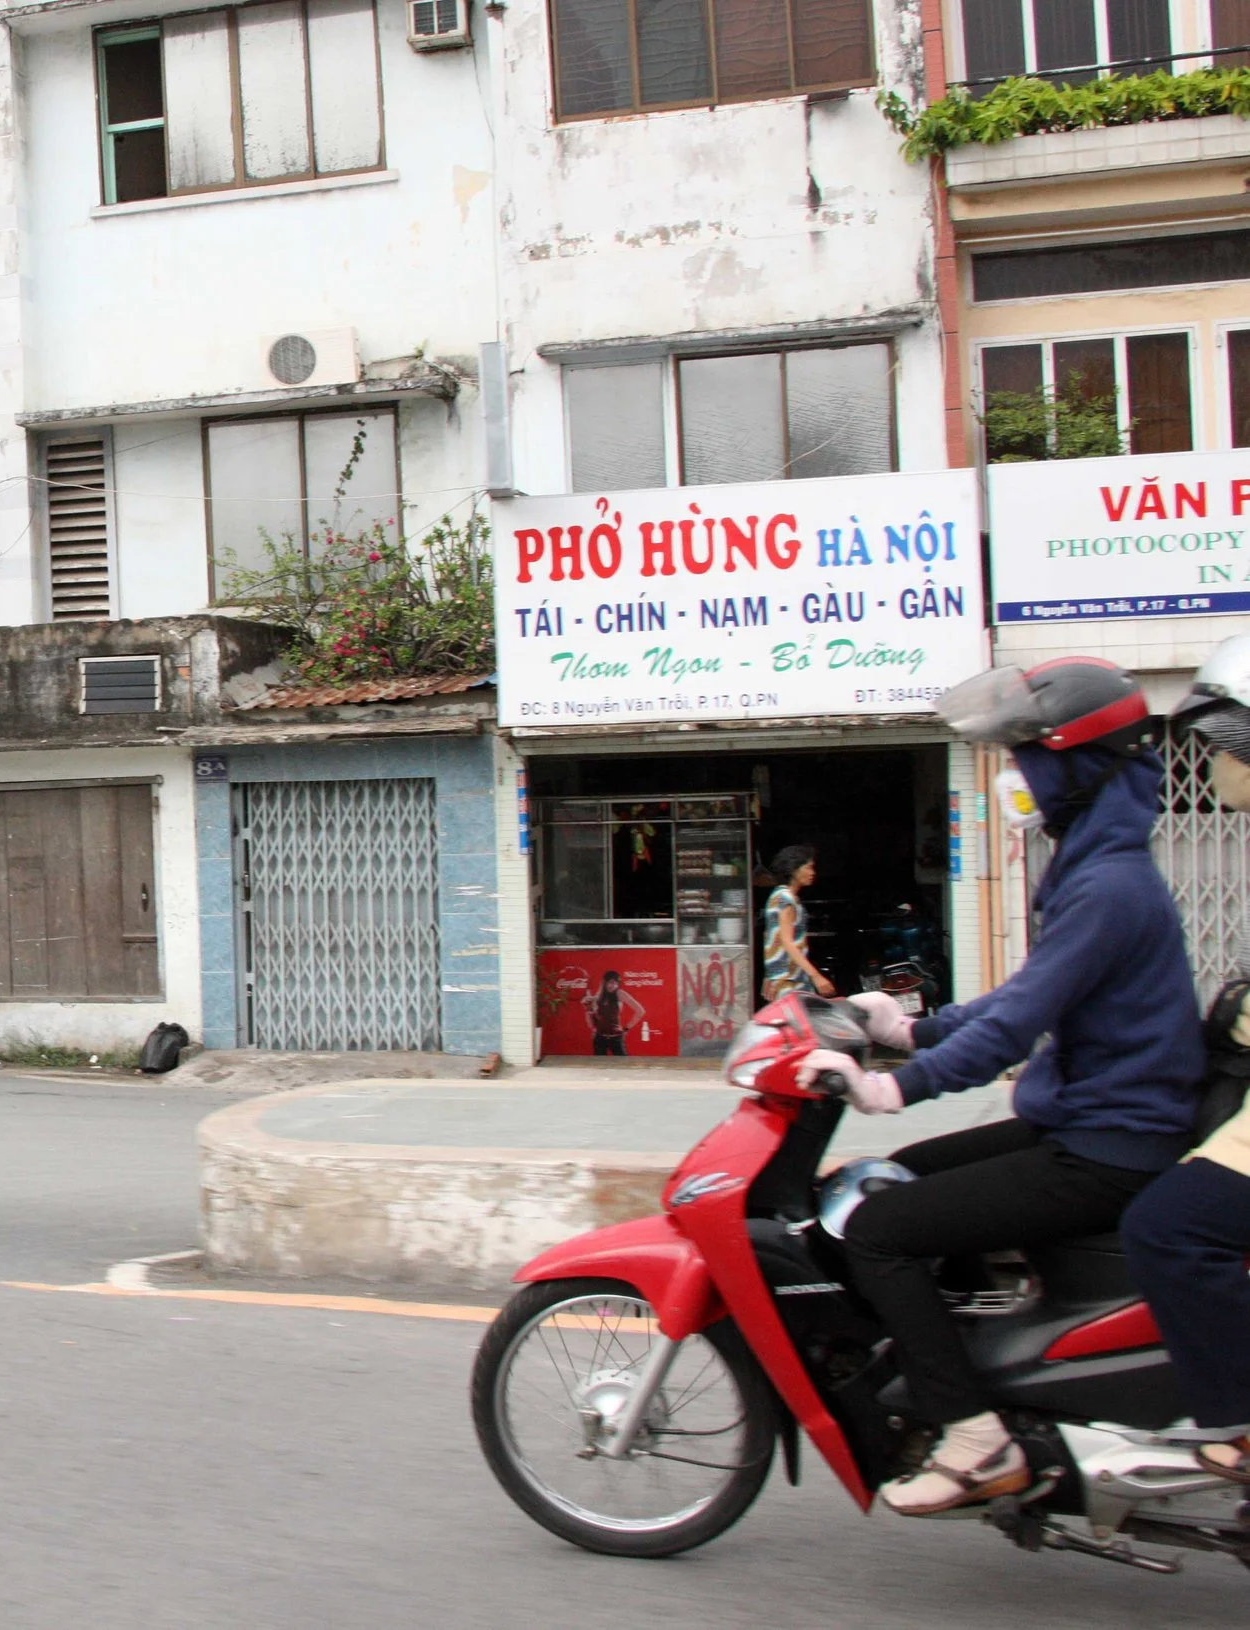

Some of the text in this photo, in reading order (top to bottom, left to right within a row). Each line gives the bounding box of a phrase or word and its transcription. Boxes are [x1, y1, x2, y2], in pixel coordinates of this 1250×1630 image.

[1099, 476, 1207, 521] VĂN
[514, 497, 956, 583] PHỞ HÙNG HÀ NỘI
[1046, 530, 1245, 558] PHOTOCOPY
[1198, 564, 1232, 583] IN
[514, 599, 564, 637] TÁI
[595, 592, 667, 634] CHÍN
[700, 596, 769, 636] NẠM
[802, 582, 865, 623] GÀU
[900, 579, 964, 619] GÂN
[550, 652, 630, 681] Thơm
[642, 646, 723, 684] Ngon
[770, 633, 816, 673] Bổ
[825, 638, 927, 675] Dưỡng
[521, 702, 548, 715] ĐC:
[553, 701, 560, 714] 8
[565, 696, 620, 717] Nguyễn
[624, 698, 654, 712] Văn
[739, 693, 778, 707] Q.PN
[855, 689, 883, 703] ĐT:
[197, 761, 226, 775] 8A
